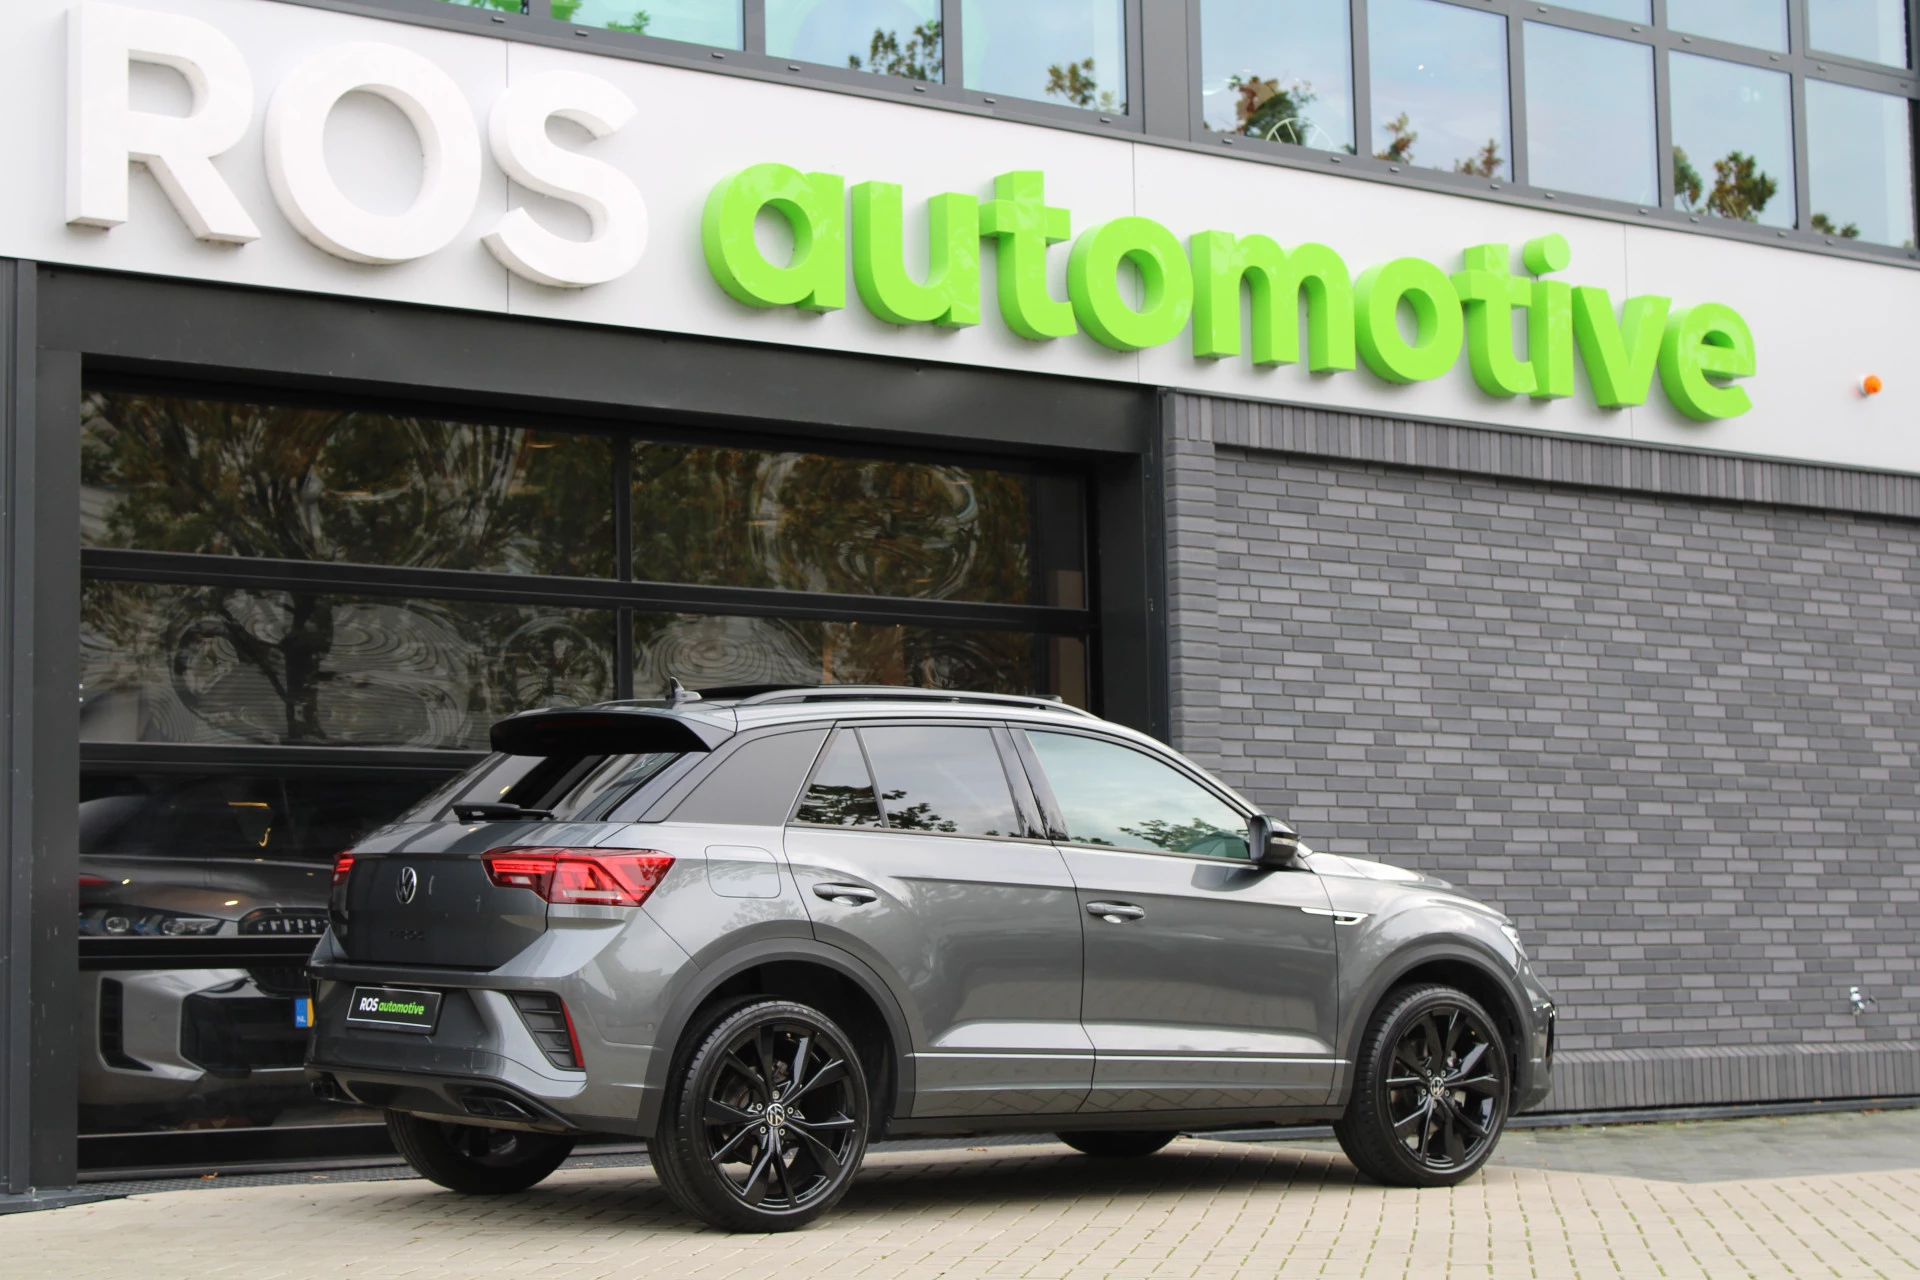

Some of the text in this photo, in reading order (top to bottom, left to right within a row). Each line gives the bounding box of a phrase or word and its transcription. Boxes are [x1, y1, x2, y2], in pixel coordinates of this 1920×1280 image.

[66, 2, 1756, 421] ROS automotive
[360, 997, 424, 1015] ROS automotive
